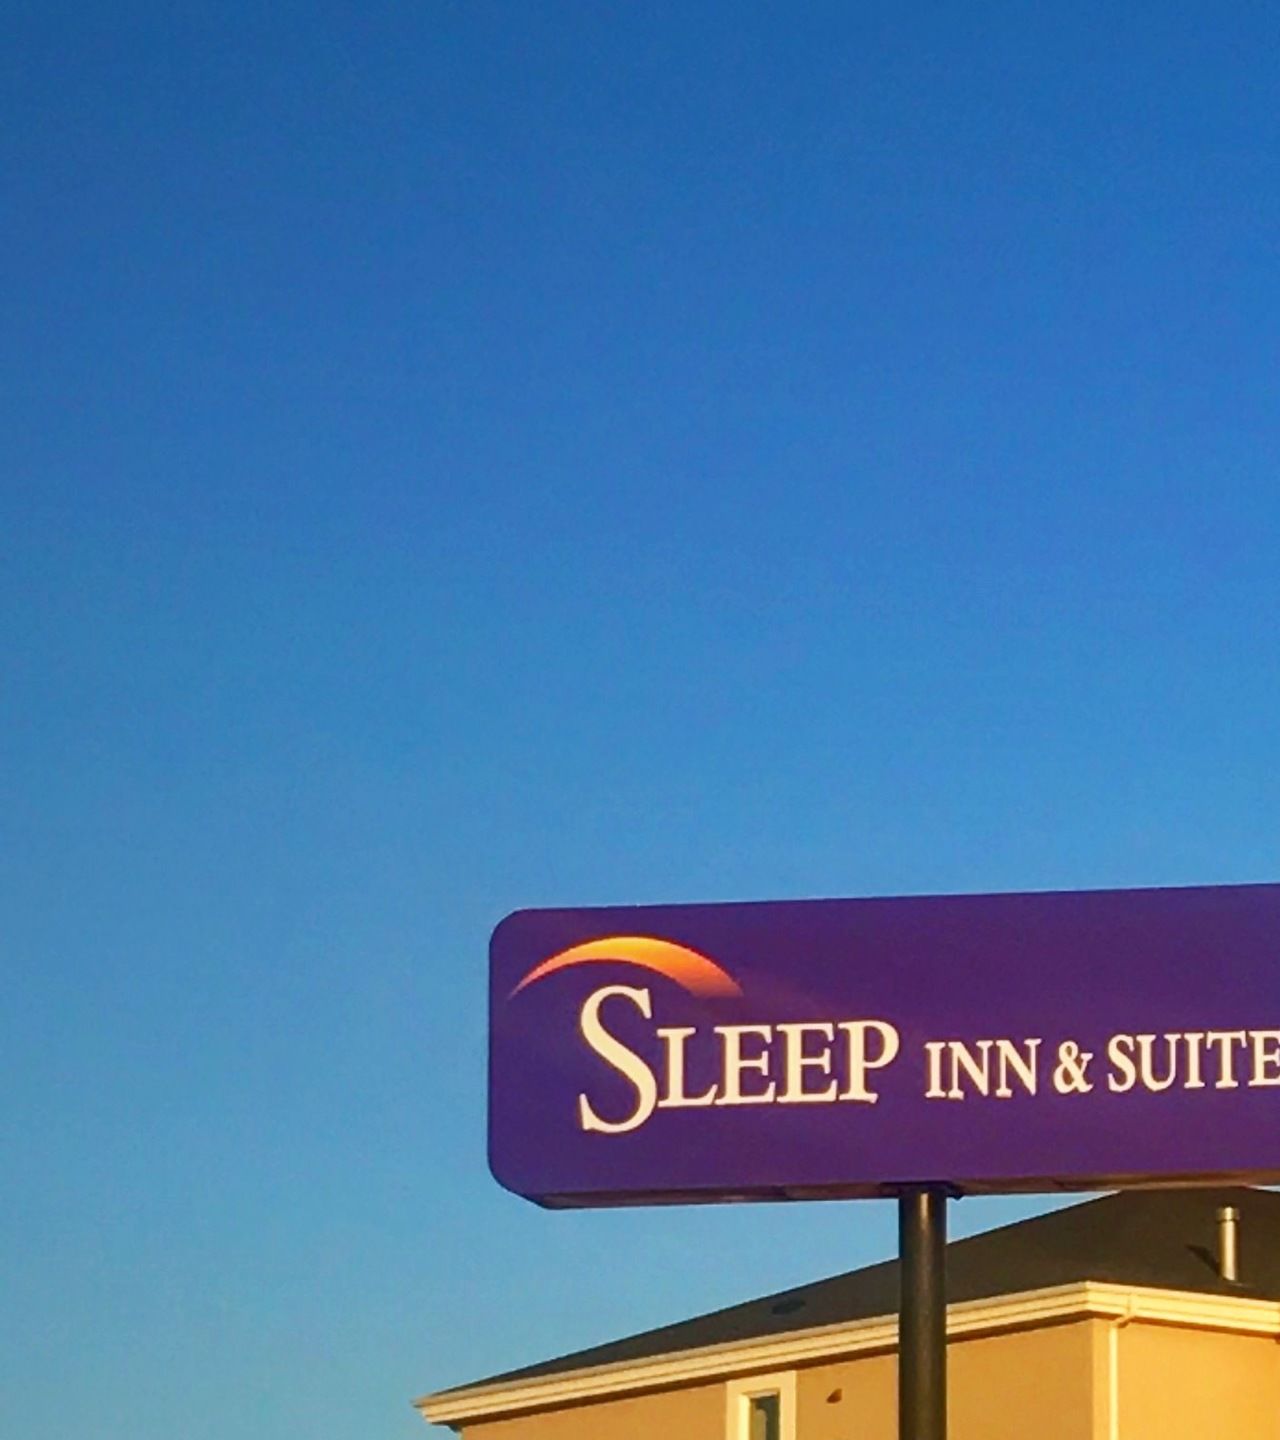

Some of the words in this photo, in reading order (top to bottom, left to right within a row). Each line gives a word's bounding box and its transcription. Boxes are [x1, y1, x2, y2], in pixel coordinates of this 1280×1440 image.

[579, 985, 900, 1133] SLEEP
[924, 1038, 1042, 1100] INN
[1053, 1040, 1093, 1094] &
